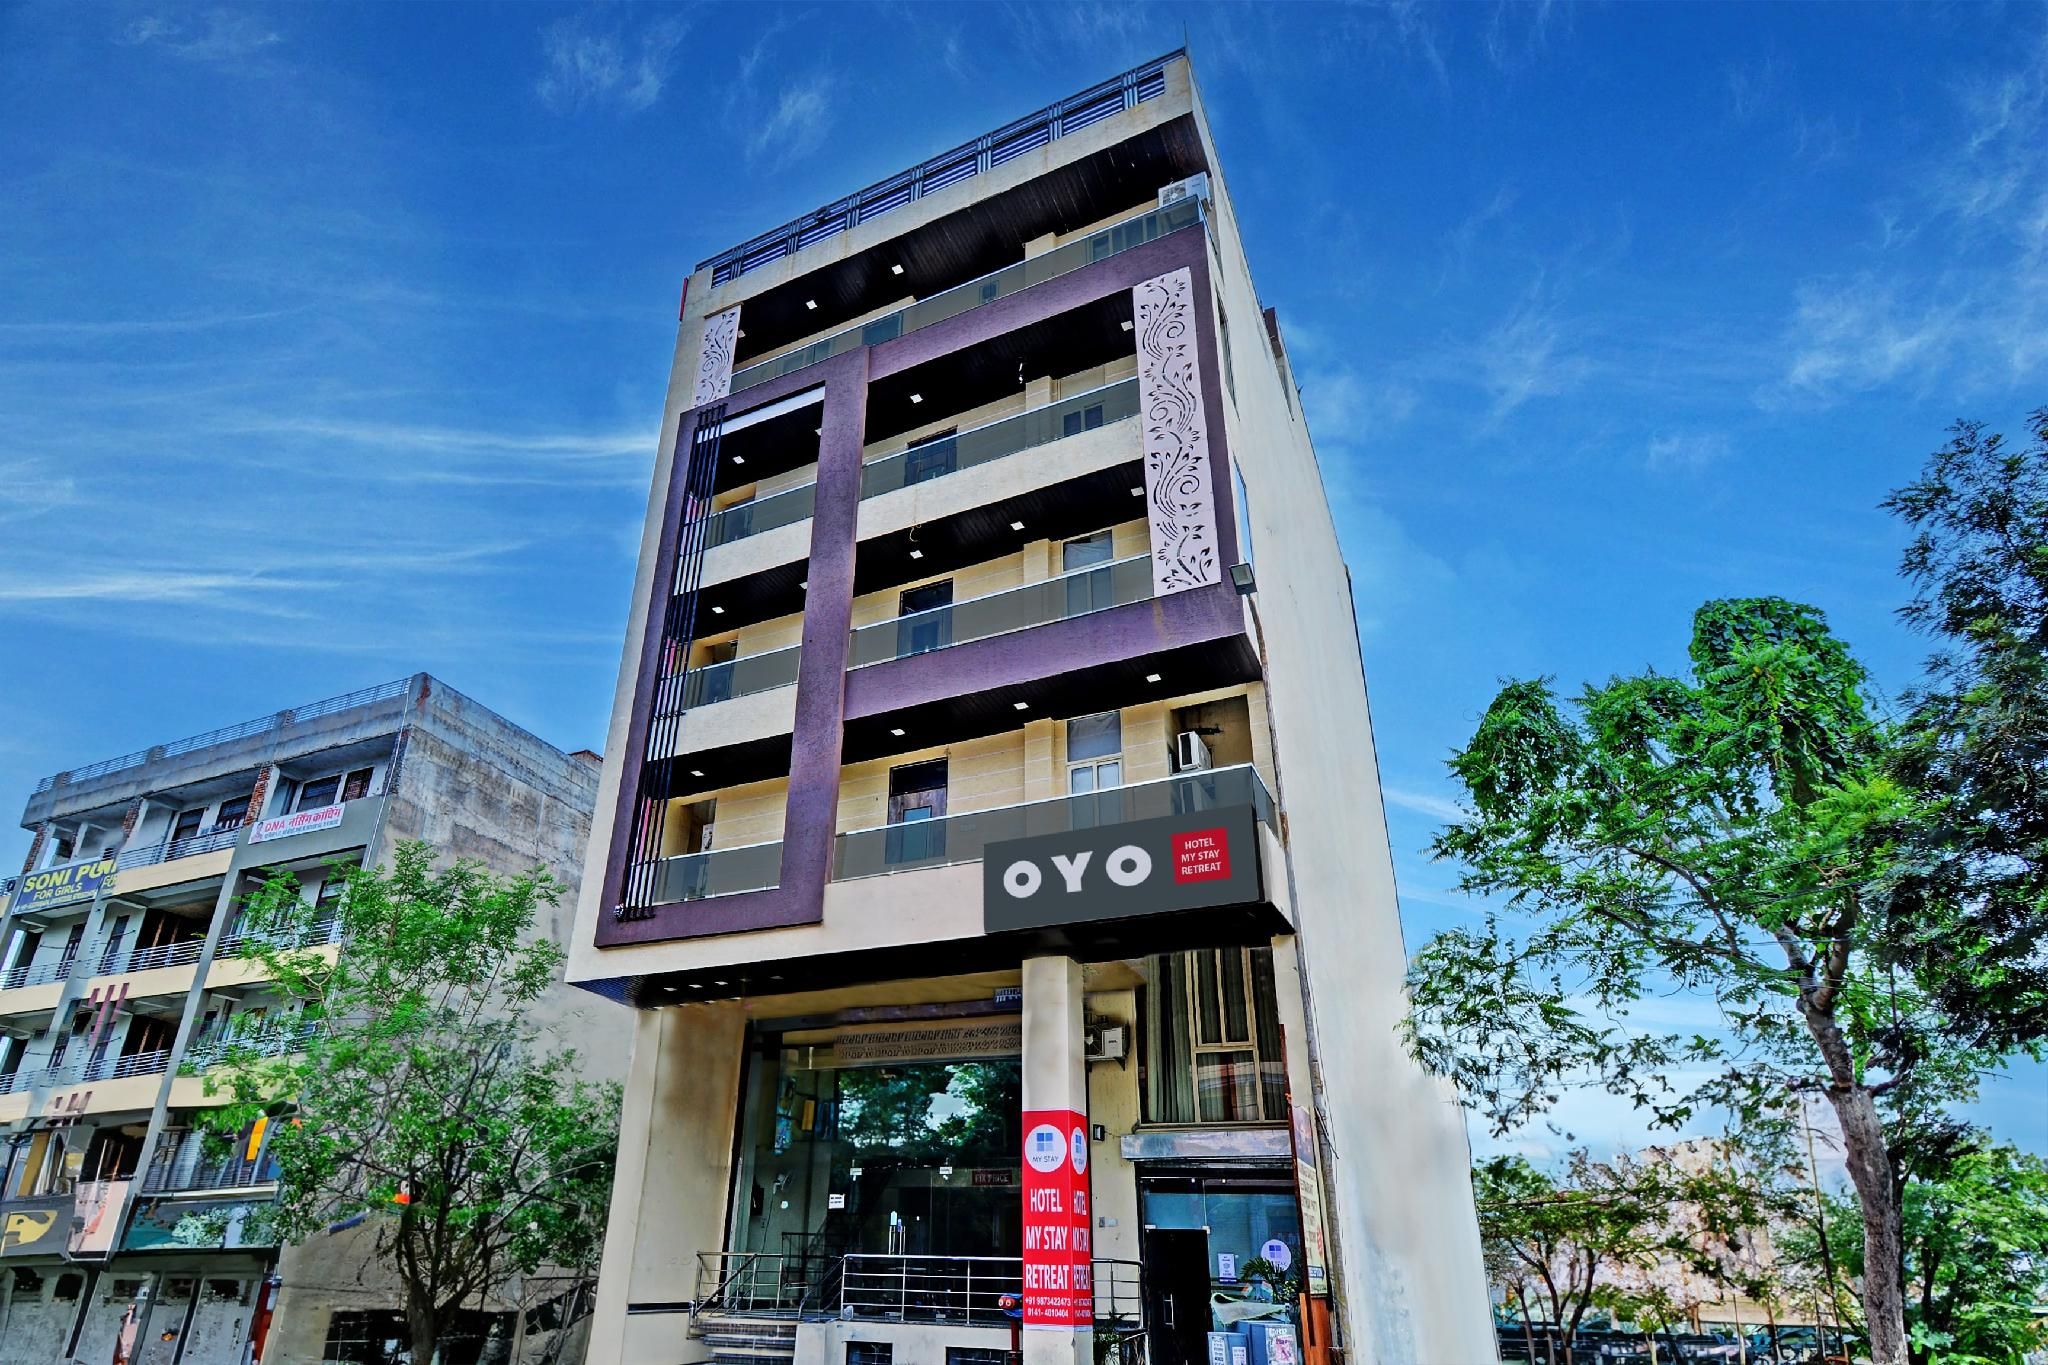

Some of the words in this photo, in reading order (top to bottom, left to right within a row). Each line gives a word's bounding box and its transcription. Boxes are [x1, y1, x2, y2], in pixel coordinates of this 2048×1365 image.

[265, 821, 285, 832] DNA
[1184, 837, 1215, 850] HOTEL
[1180, 853, 1196, 864] MY
[1197, 849, 1220, 861] STAY
[1002, 845, 1152, 899] OYO
[1180, 861, 1222, 876] RETREAT
[23, 869, 72, 892] SONI
[33, 889, 54, 901] FOR
[55, 882, 82, 896] GIRLS
[1043, 1155, 1059, 1163] STAY
[1030, 1188, 1063, 1212] HOTEL
[1025, 1225, 1042, 1250] MY
[1043, 1225, 1068, 1250] STAY
[1025, 1263, 1070, 1290] RETREAT
[1025, 1296, 1036, 1305] +91
